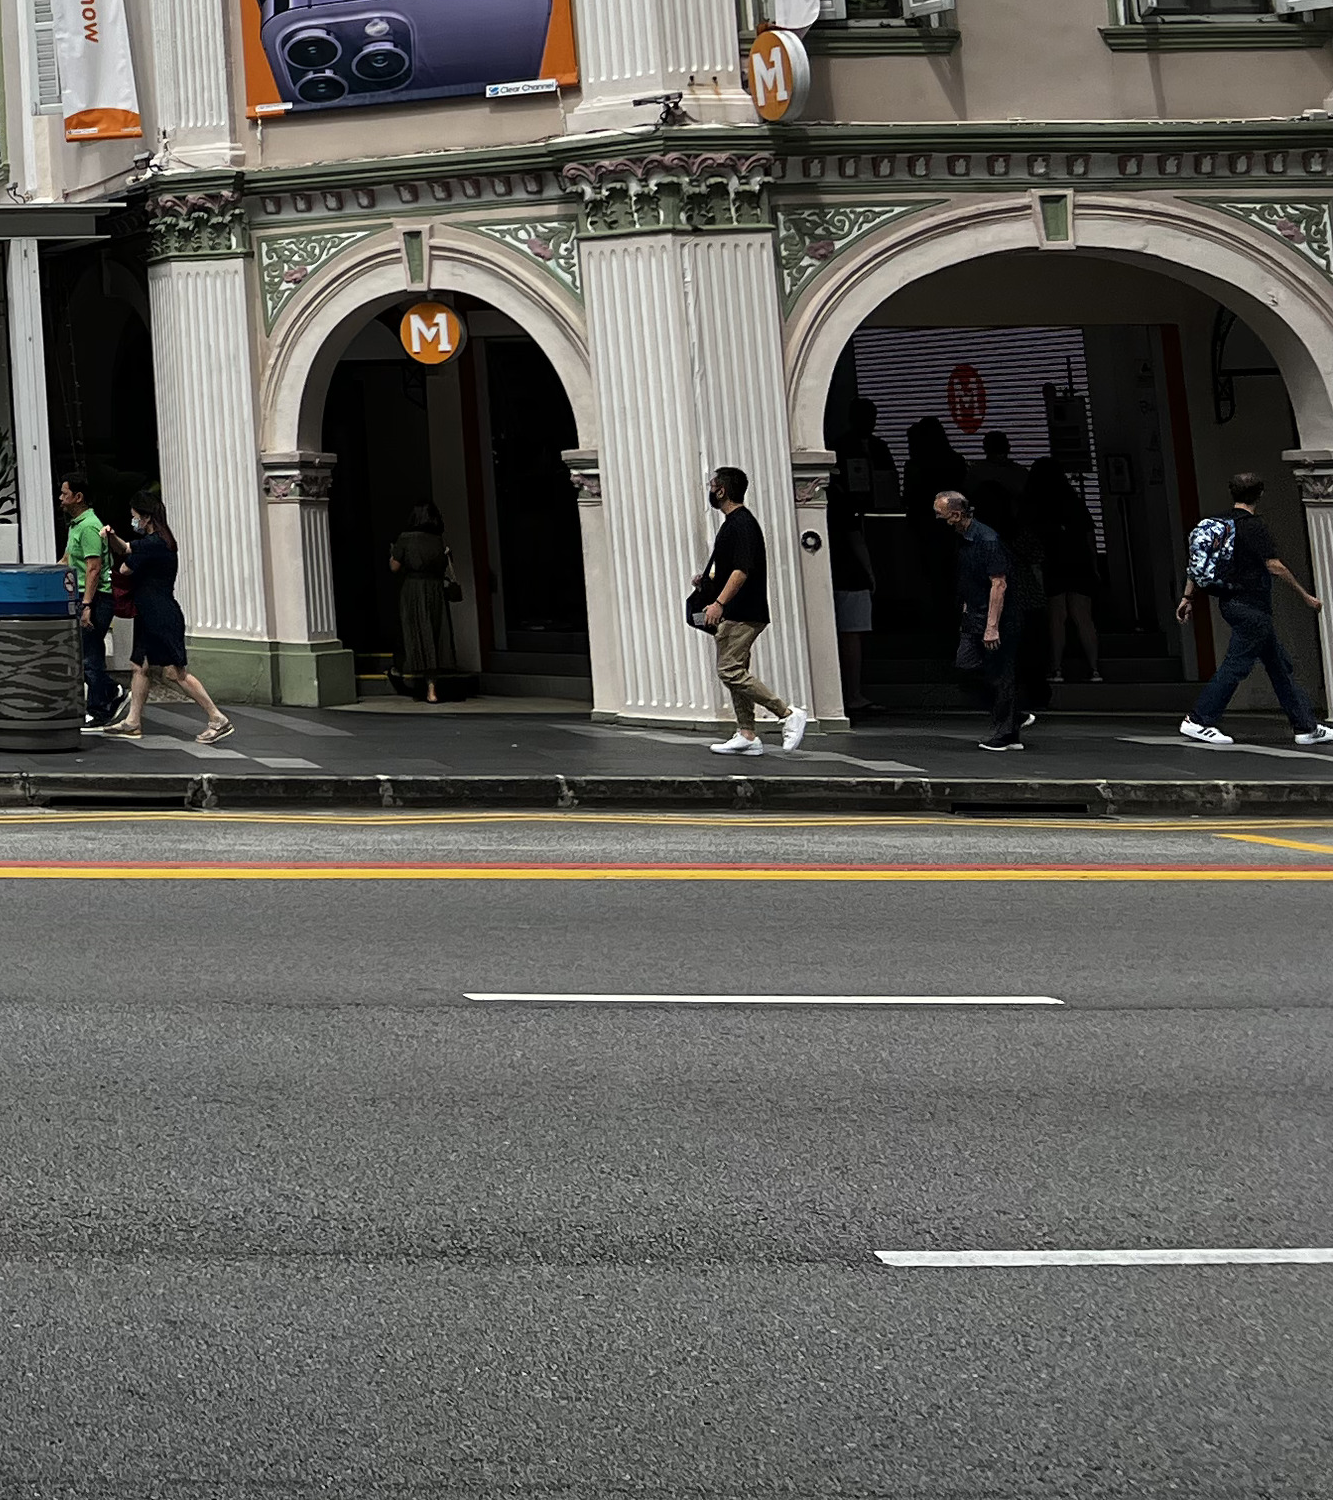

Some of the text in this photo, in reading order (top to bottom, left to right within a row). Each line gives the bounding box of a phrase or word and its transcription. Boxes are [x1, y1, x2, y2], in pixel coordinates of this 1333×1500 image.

[500, 81, 555, 94] Clear Channel
[751, 45, 789, 107] M1
[409, 311, 452, 354] M1
